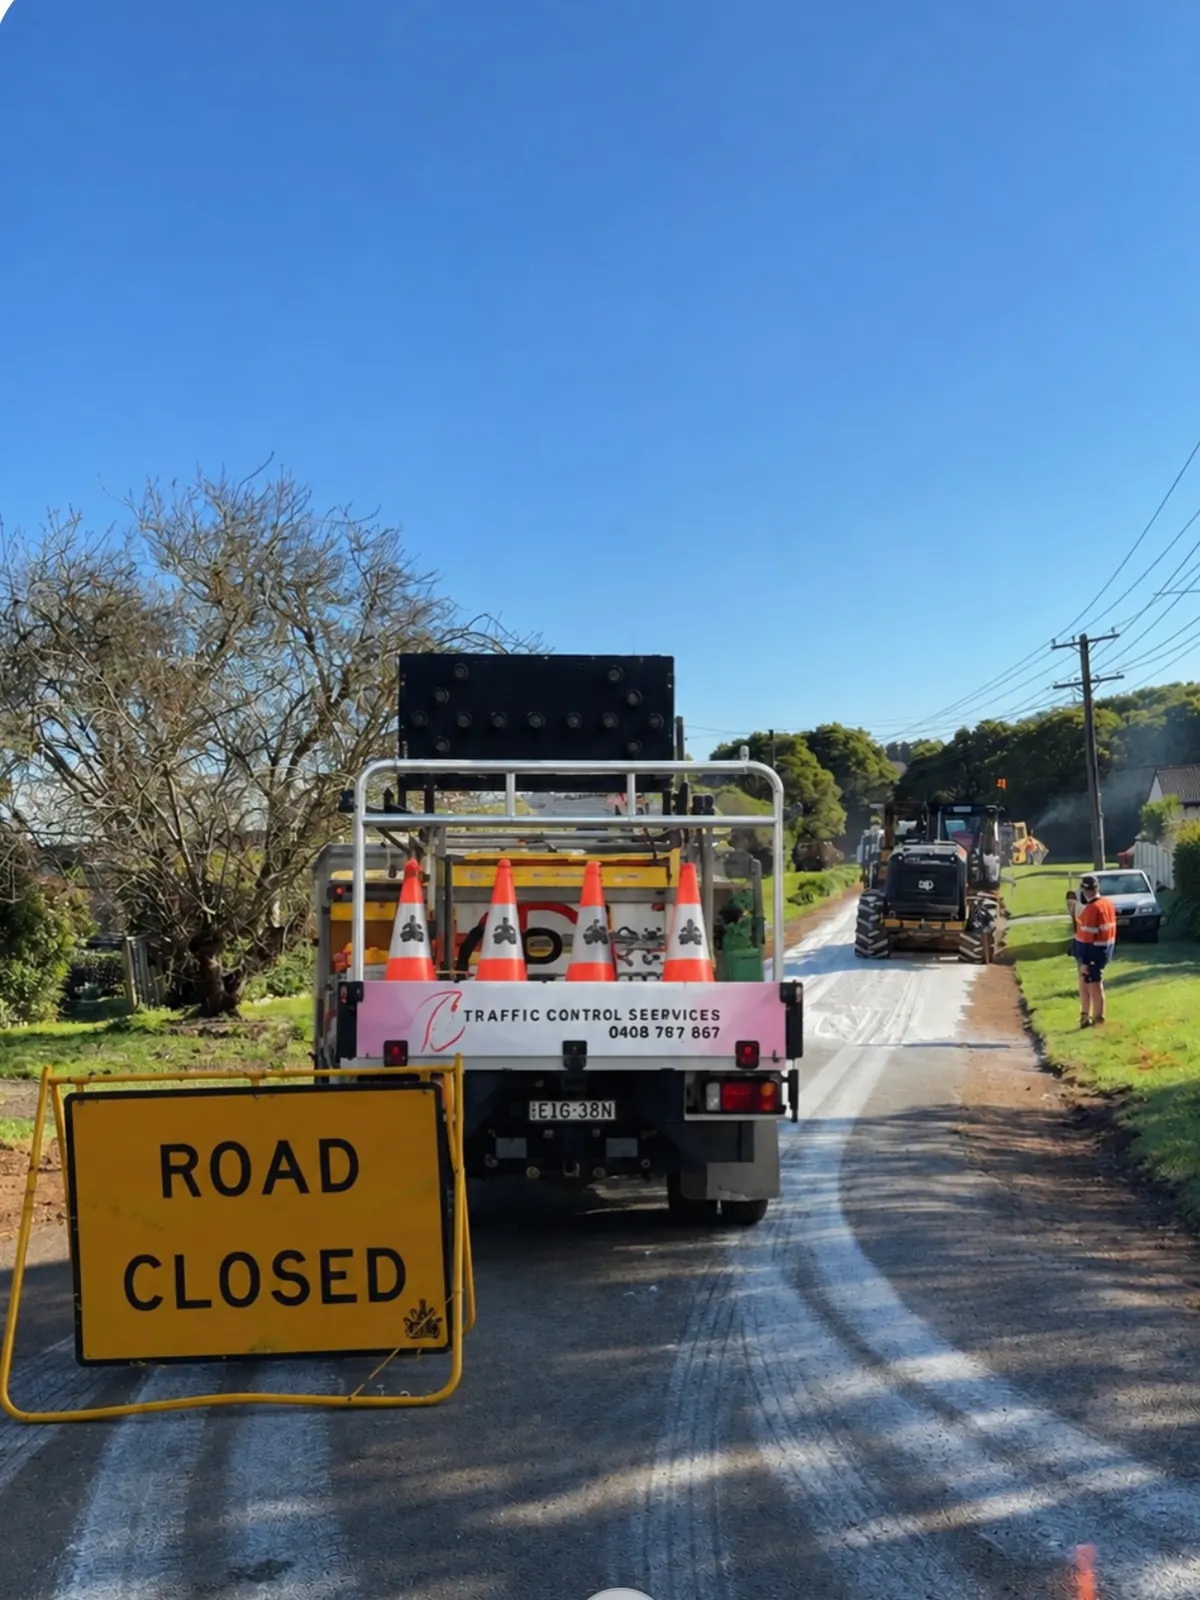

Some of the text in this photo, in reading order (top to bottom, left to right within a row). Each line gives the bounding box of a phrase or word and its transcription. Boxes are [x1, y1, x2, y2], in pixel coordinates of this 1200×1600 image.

[463, 1009, 540, 1022] TRAFFIC
[546, 1008, 622, 1021] CONTROL
[608, 1025, 649, 1039] 0408
[691, 1026, 720, 1039] 867
[160, 1138, 360, 1198] ROAD
[124, 1247, 406, 1311] CLOSED
